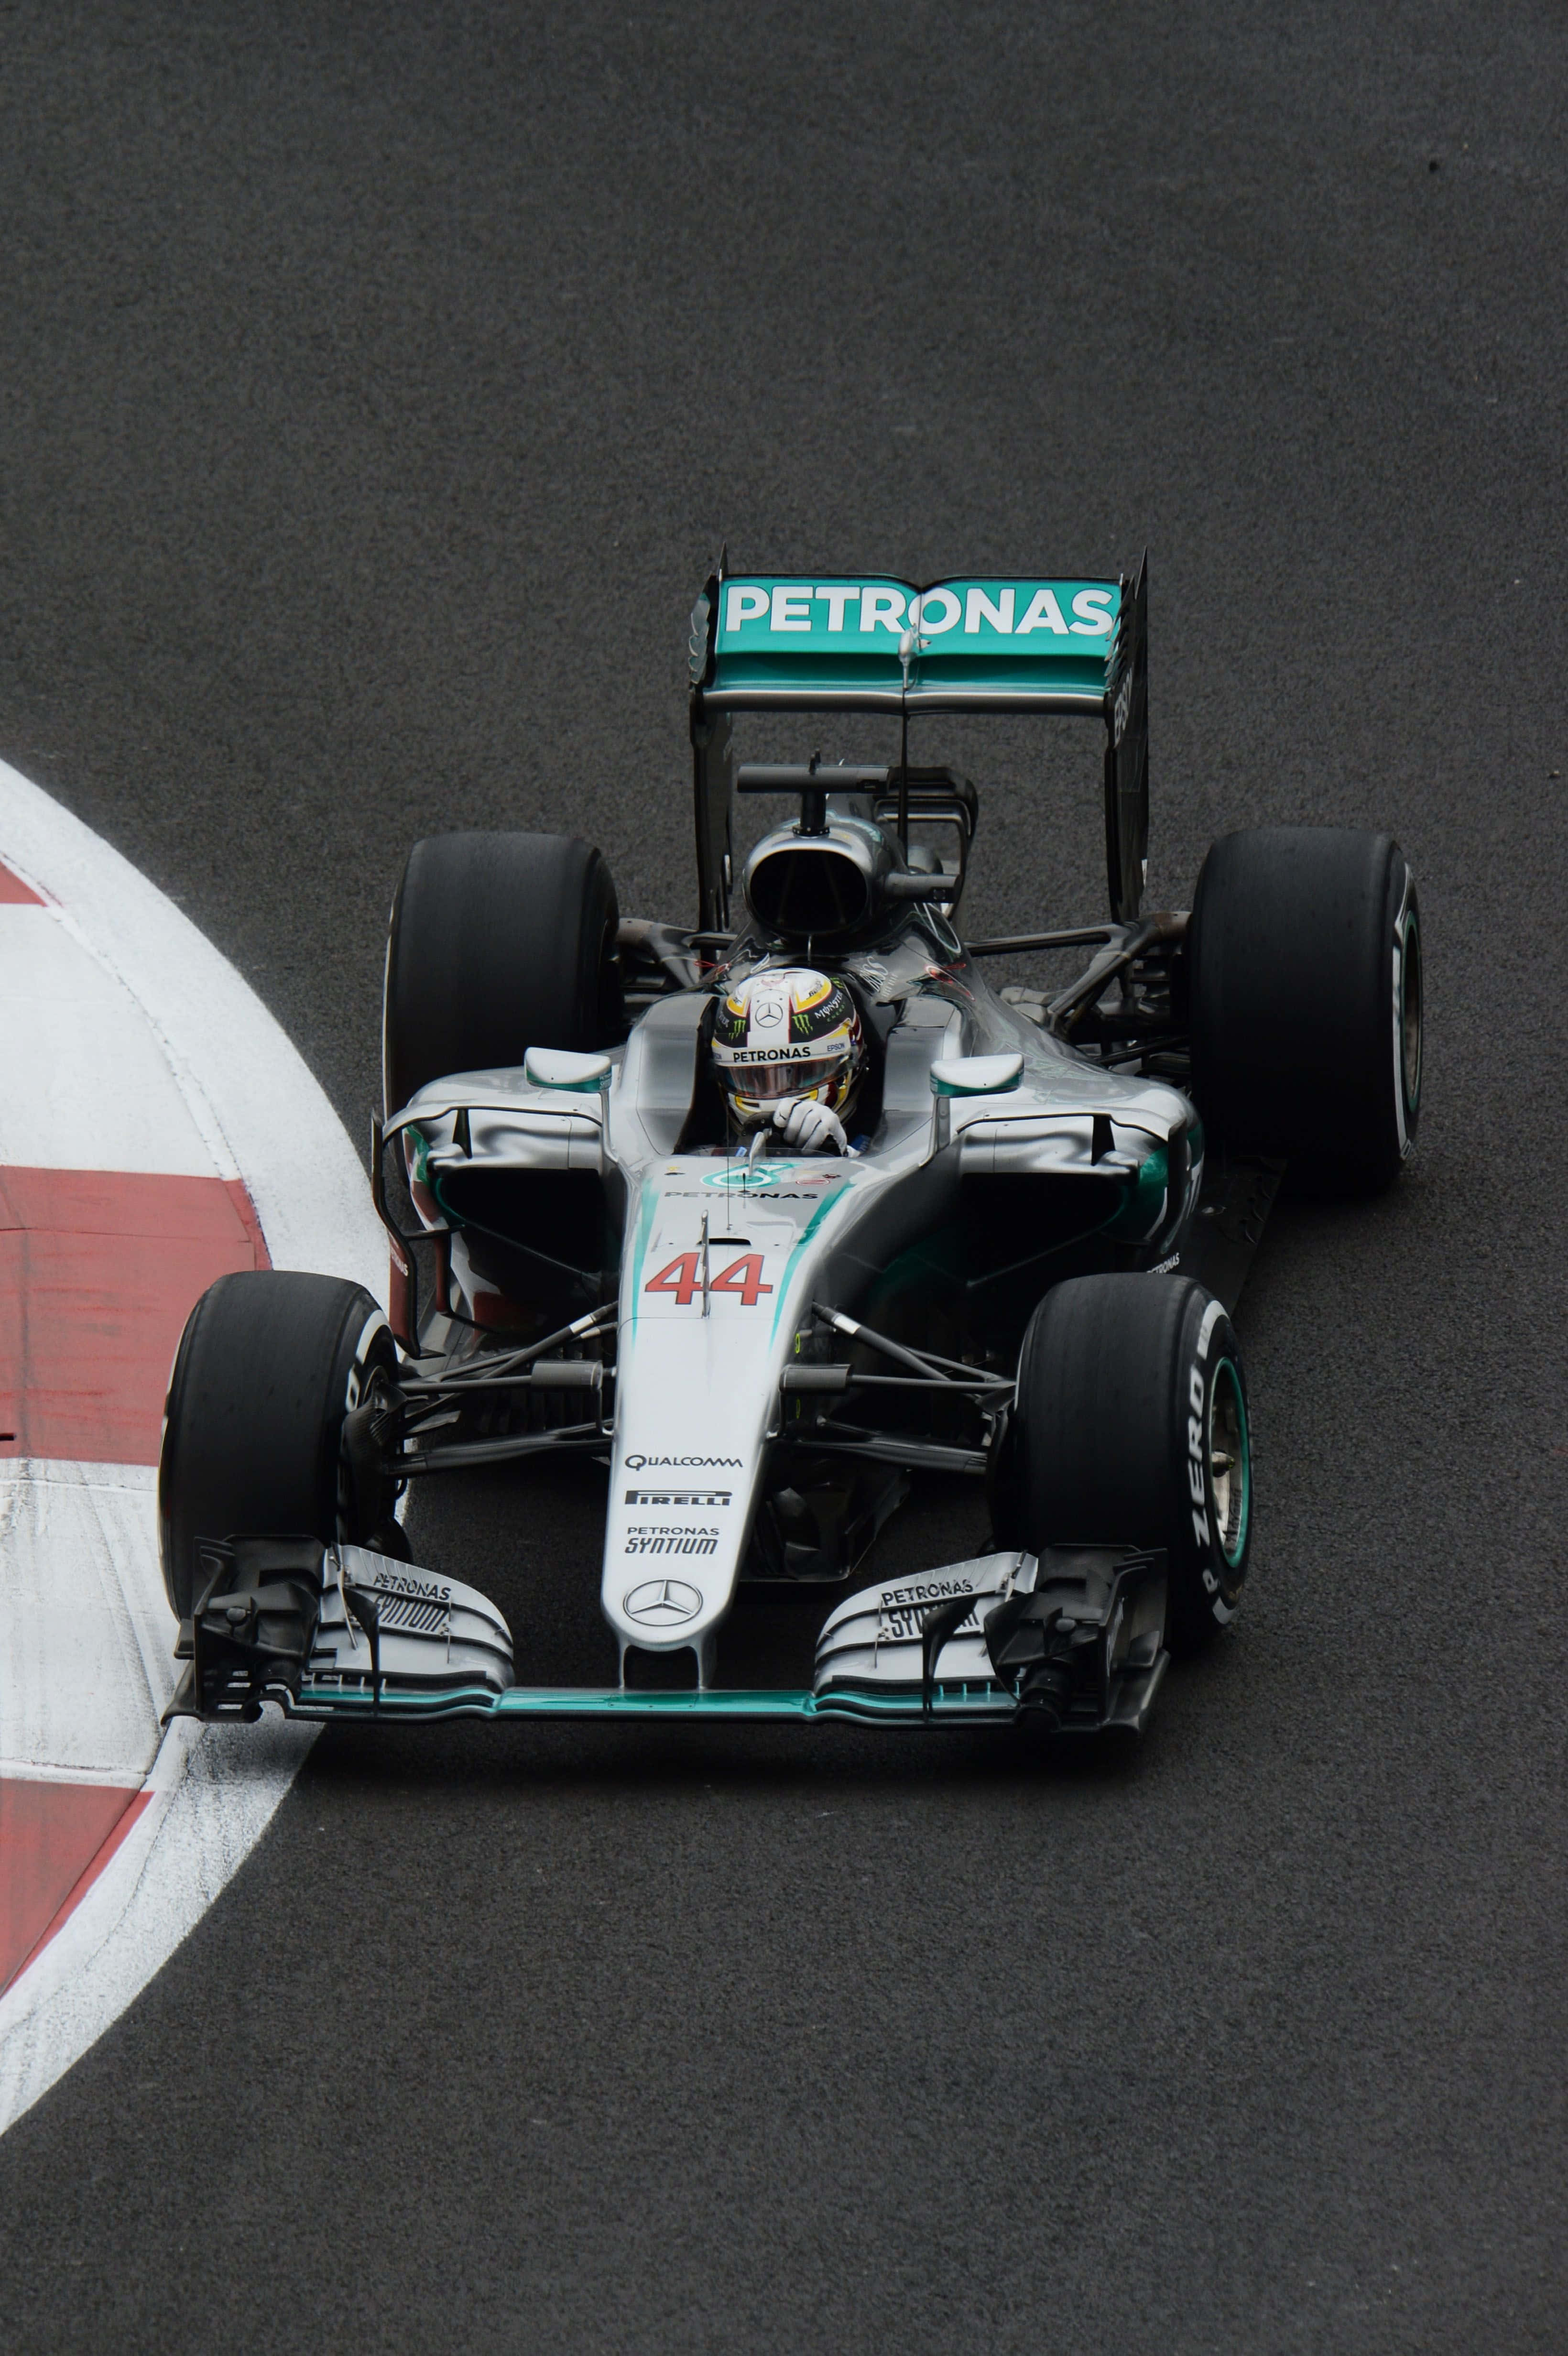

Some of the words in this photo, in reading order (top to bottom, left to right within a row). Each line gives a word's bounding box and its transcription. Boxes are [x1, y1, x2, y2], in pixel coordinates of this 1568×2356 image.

[725, 585, 1113, 635] PETRONAS
[733, 1047, 811, 1063] PETRONAS
[827, 1043, 845, 1052] EPSON
[664, 1191, 819, 1200] PETRONAS
[644, 1252, 773, 1306] 44
[1188, 1363, 1209, 1547] ZERO
[624, 1490, 732, 1506] PIRELLI
[627, 1527, 719, 1536] PETRONAS
[624, 1538, 718, 1554] SYNTIUM
[374, 1573, 451, 1601] PETRONAS
[882, 1579, 973, 1606] PETRONAS
